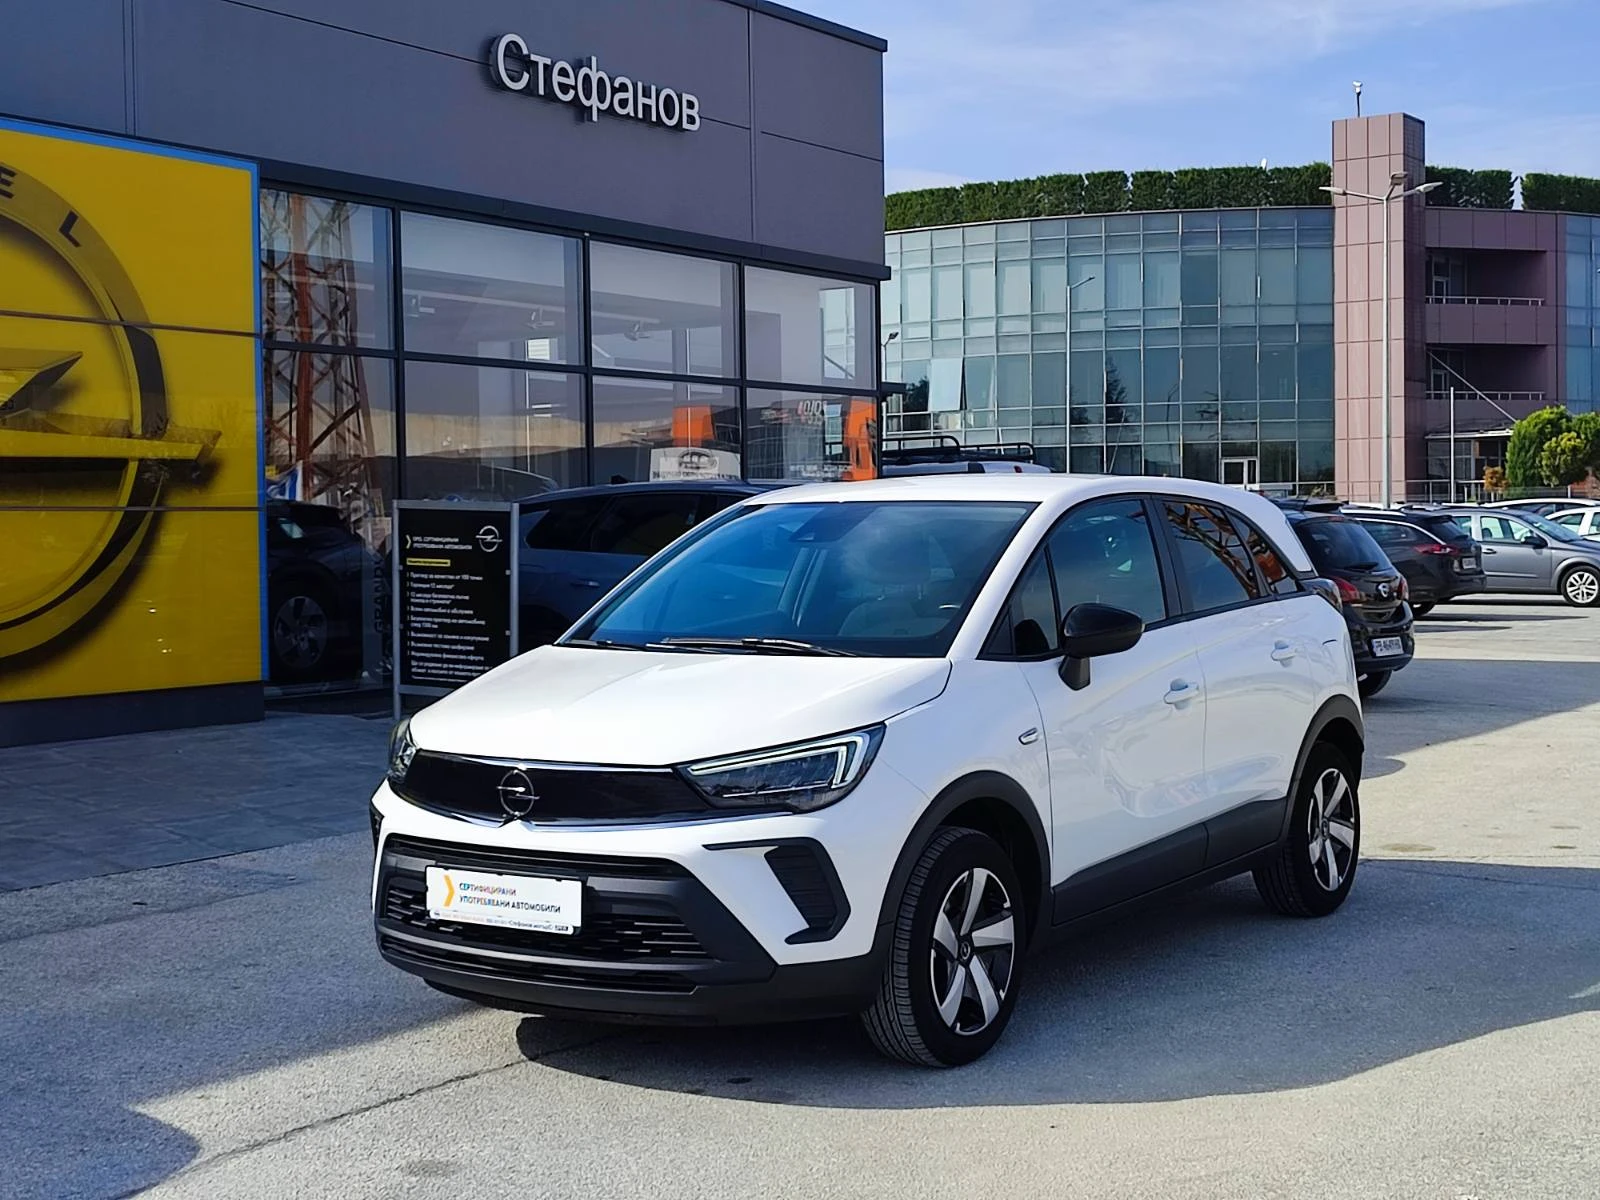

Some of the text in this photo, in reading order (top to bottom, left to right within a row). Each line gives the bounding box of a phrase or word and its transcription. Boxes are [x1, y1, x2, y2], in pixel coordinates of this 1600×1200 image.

[496, 33, 701, 131] Стефанов
[459, 882, 517, 896] СЕРТИФИЦИРАНИ
[459, 895, 561, 914] УПОТРЕБЯВАНИ АВТОМОБИЛИ
